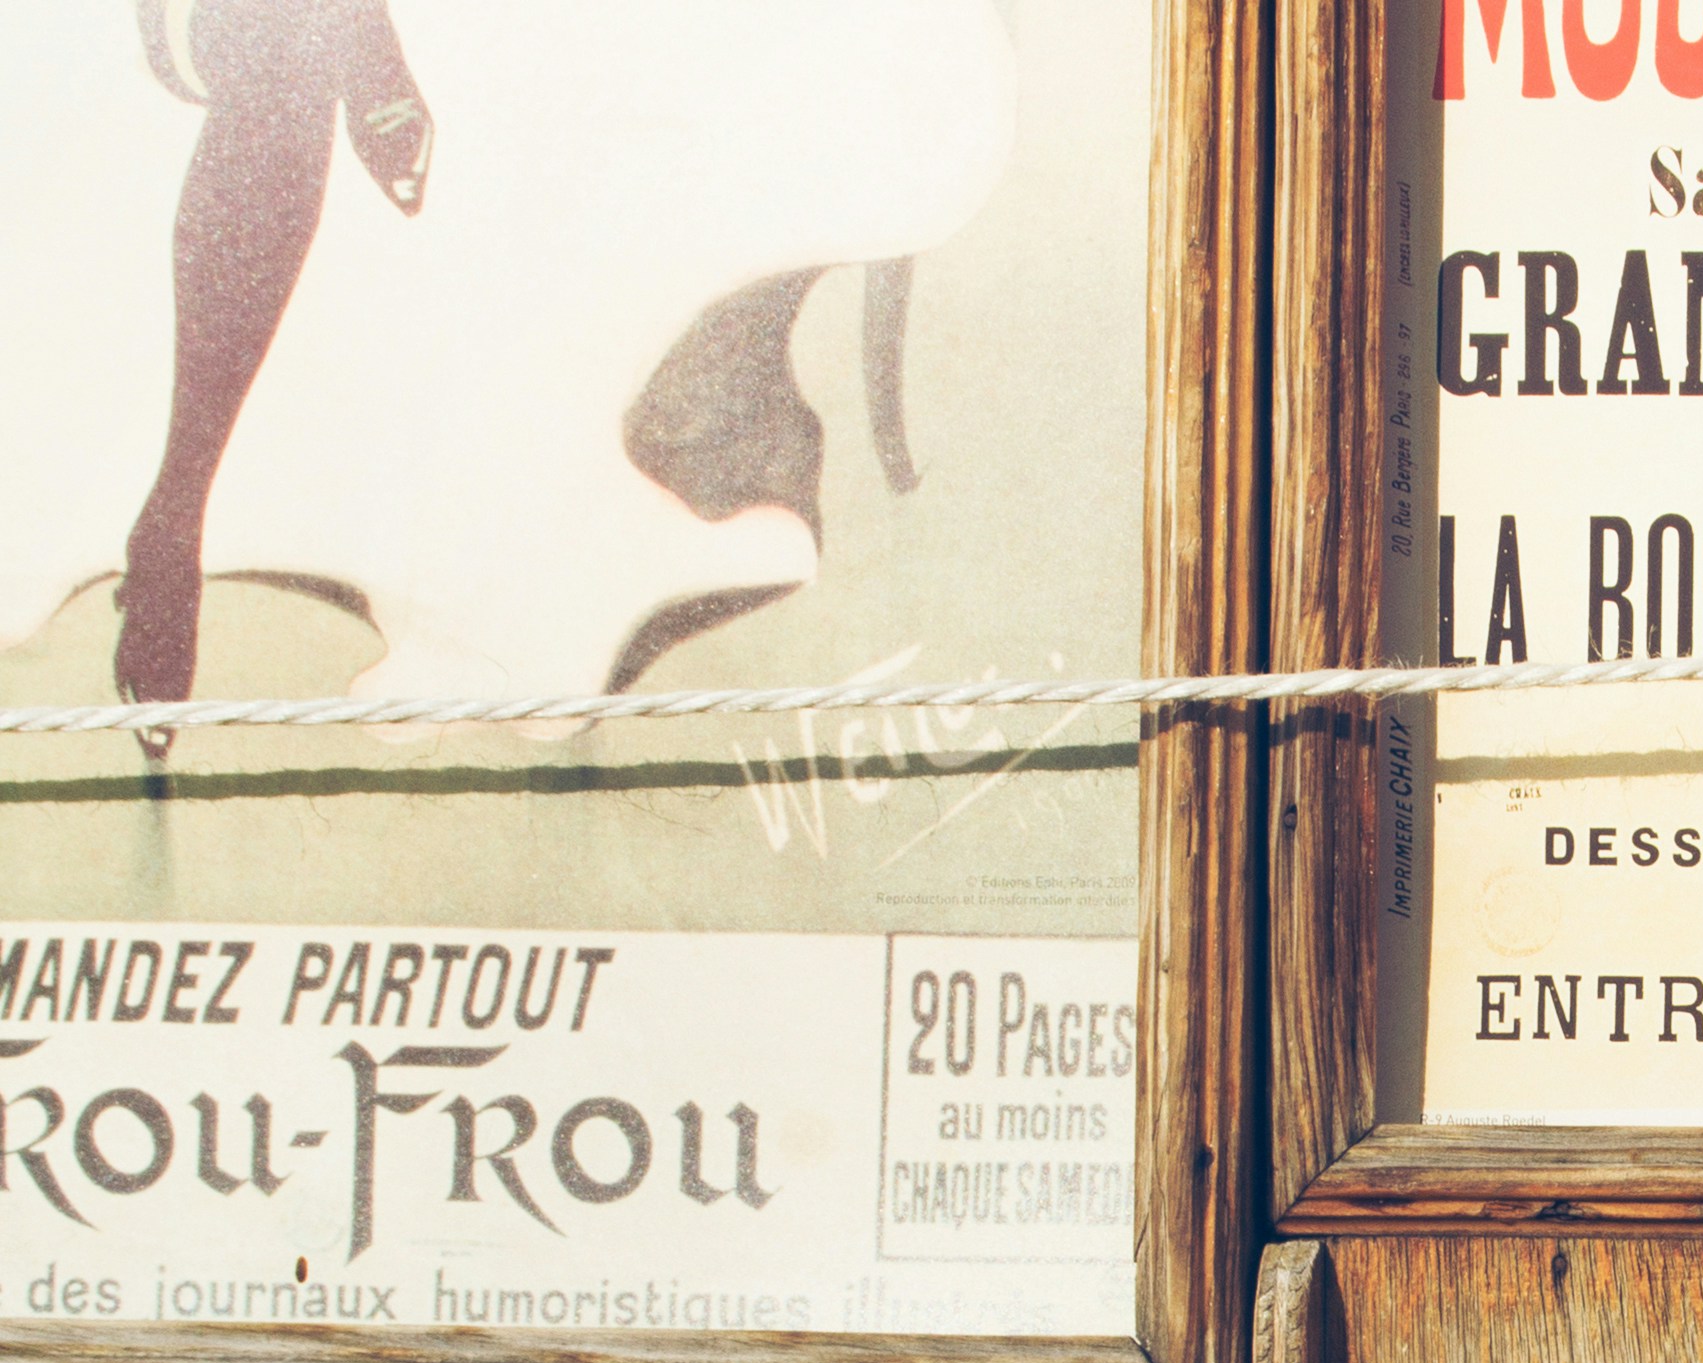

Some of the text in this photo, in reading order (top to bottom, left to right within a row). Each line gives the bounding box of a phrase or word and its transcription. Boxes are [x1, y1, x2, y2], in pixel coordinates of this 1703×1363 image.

[1391, 499, 1412, 528] Rue
[1438, 514, 1529, 668] LA
[1389, 716, 1412, 797] CHAIX
[1388, 799, 1413, 918] IMPRIMERIE
[281, 940, 616, 1032] PARTOUT
[907, 969, 978, 1077] 20
[938, 1088, 1108, 1141] au moins
[892, 1161, 1009, 1230] CHAQUE
[27, 1261, 123, 1315] des
[154, 1264, 399, 1321] journaux
[433, 1267, 814, 1330] humoristiques
